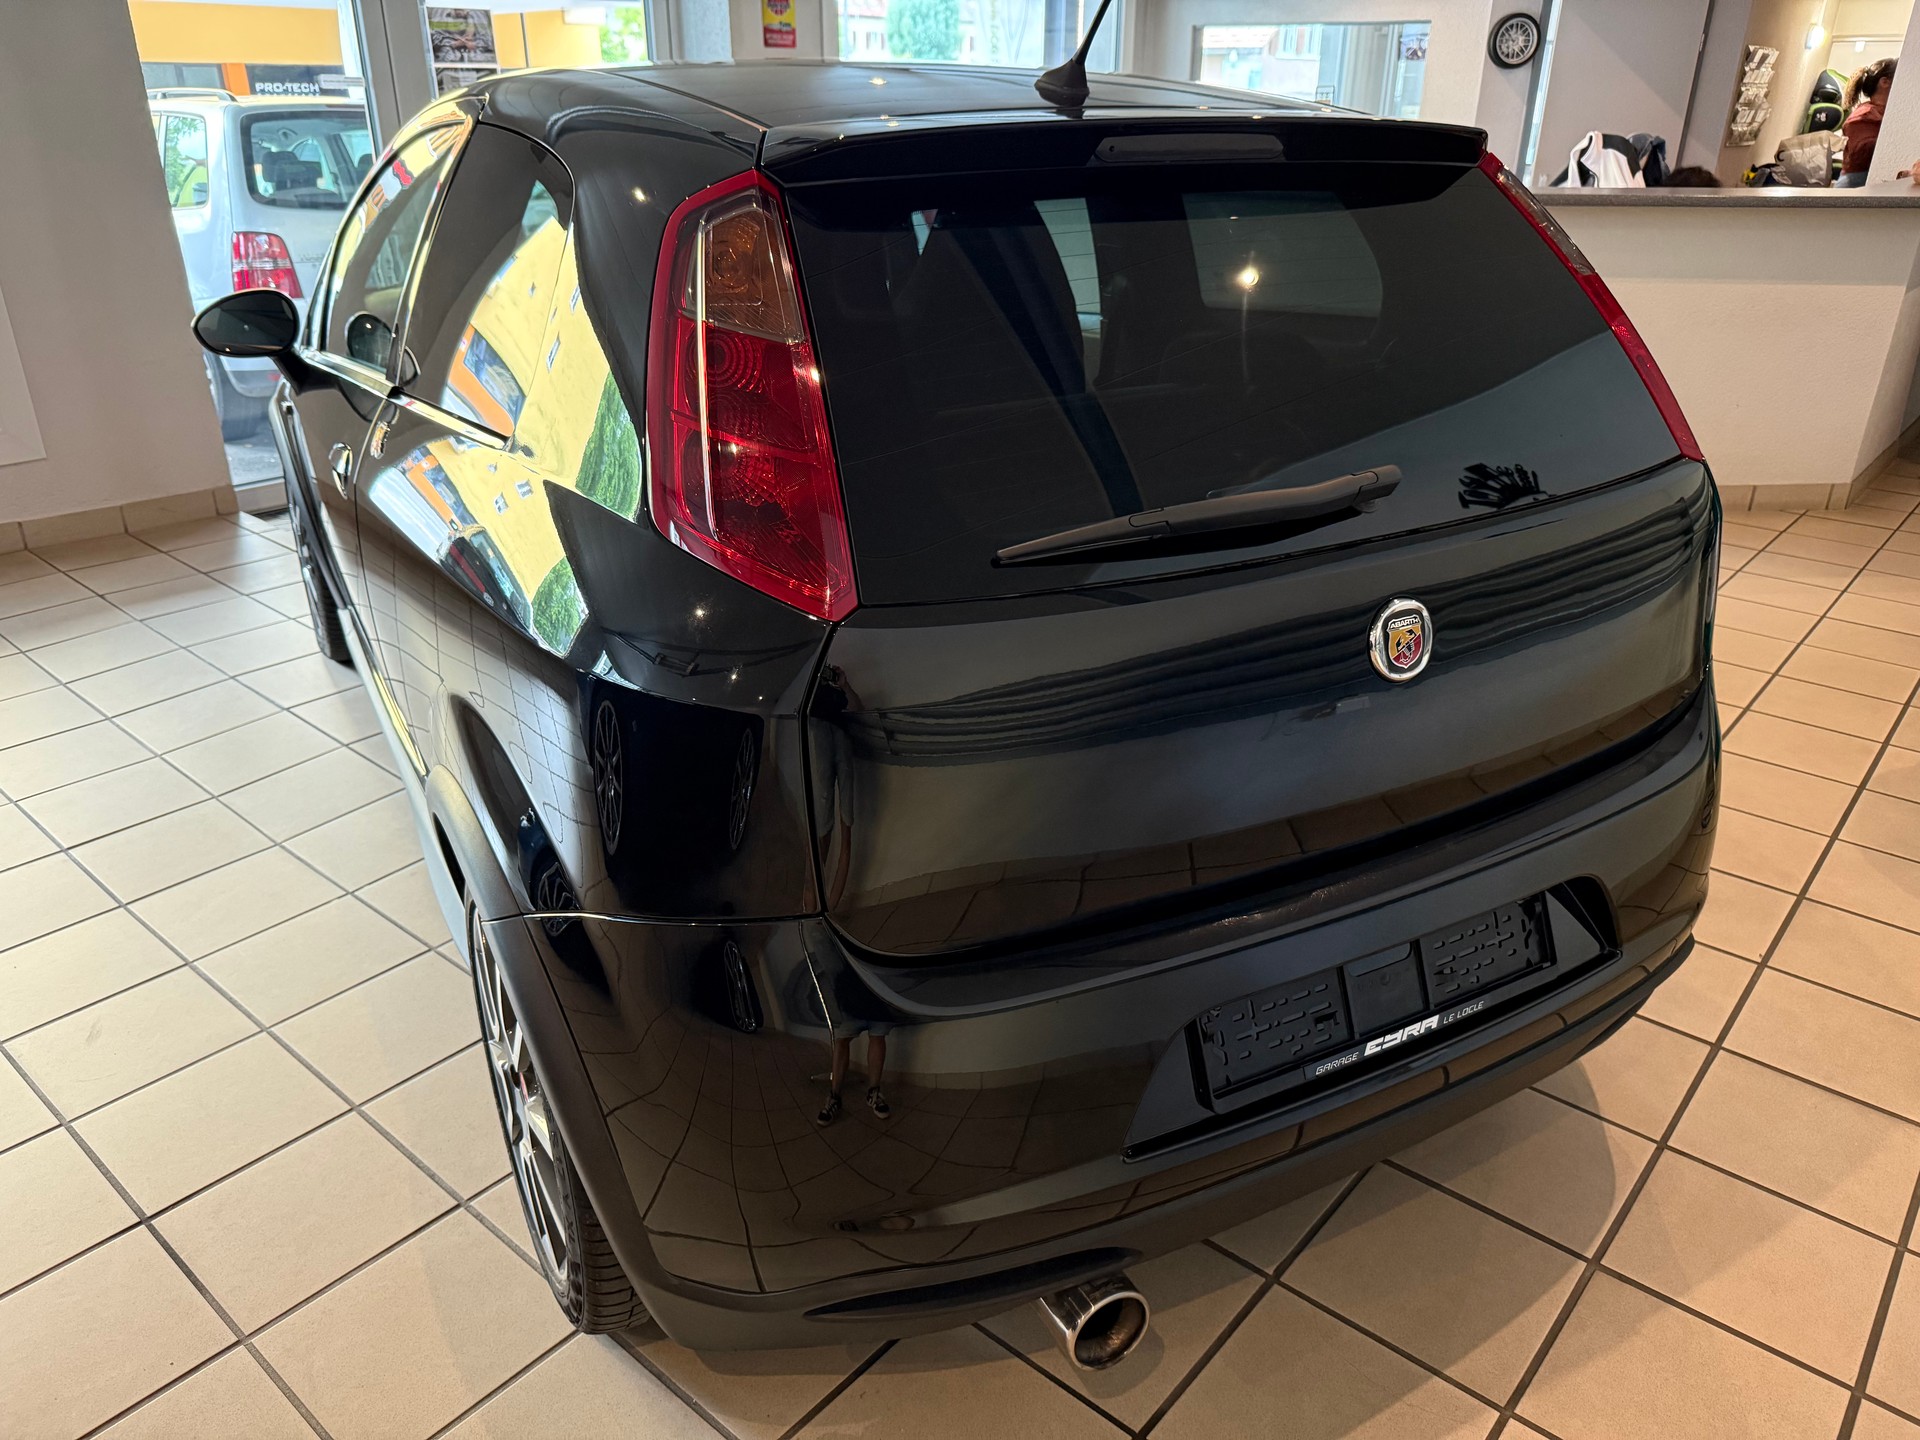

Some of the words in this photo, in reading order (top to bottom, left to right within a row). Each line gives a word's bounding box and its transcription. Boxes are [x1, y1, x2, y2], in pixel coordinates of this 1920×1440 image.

[1389, 618, 1419, 629] ABARTH
[1315, 1051, 1359, 1075] GARAGE
[1443, 1012, 1455, 1024] LE
[1457, 1001, 1484, 1019] LOCLE
